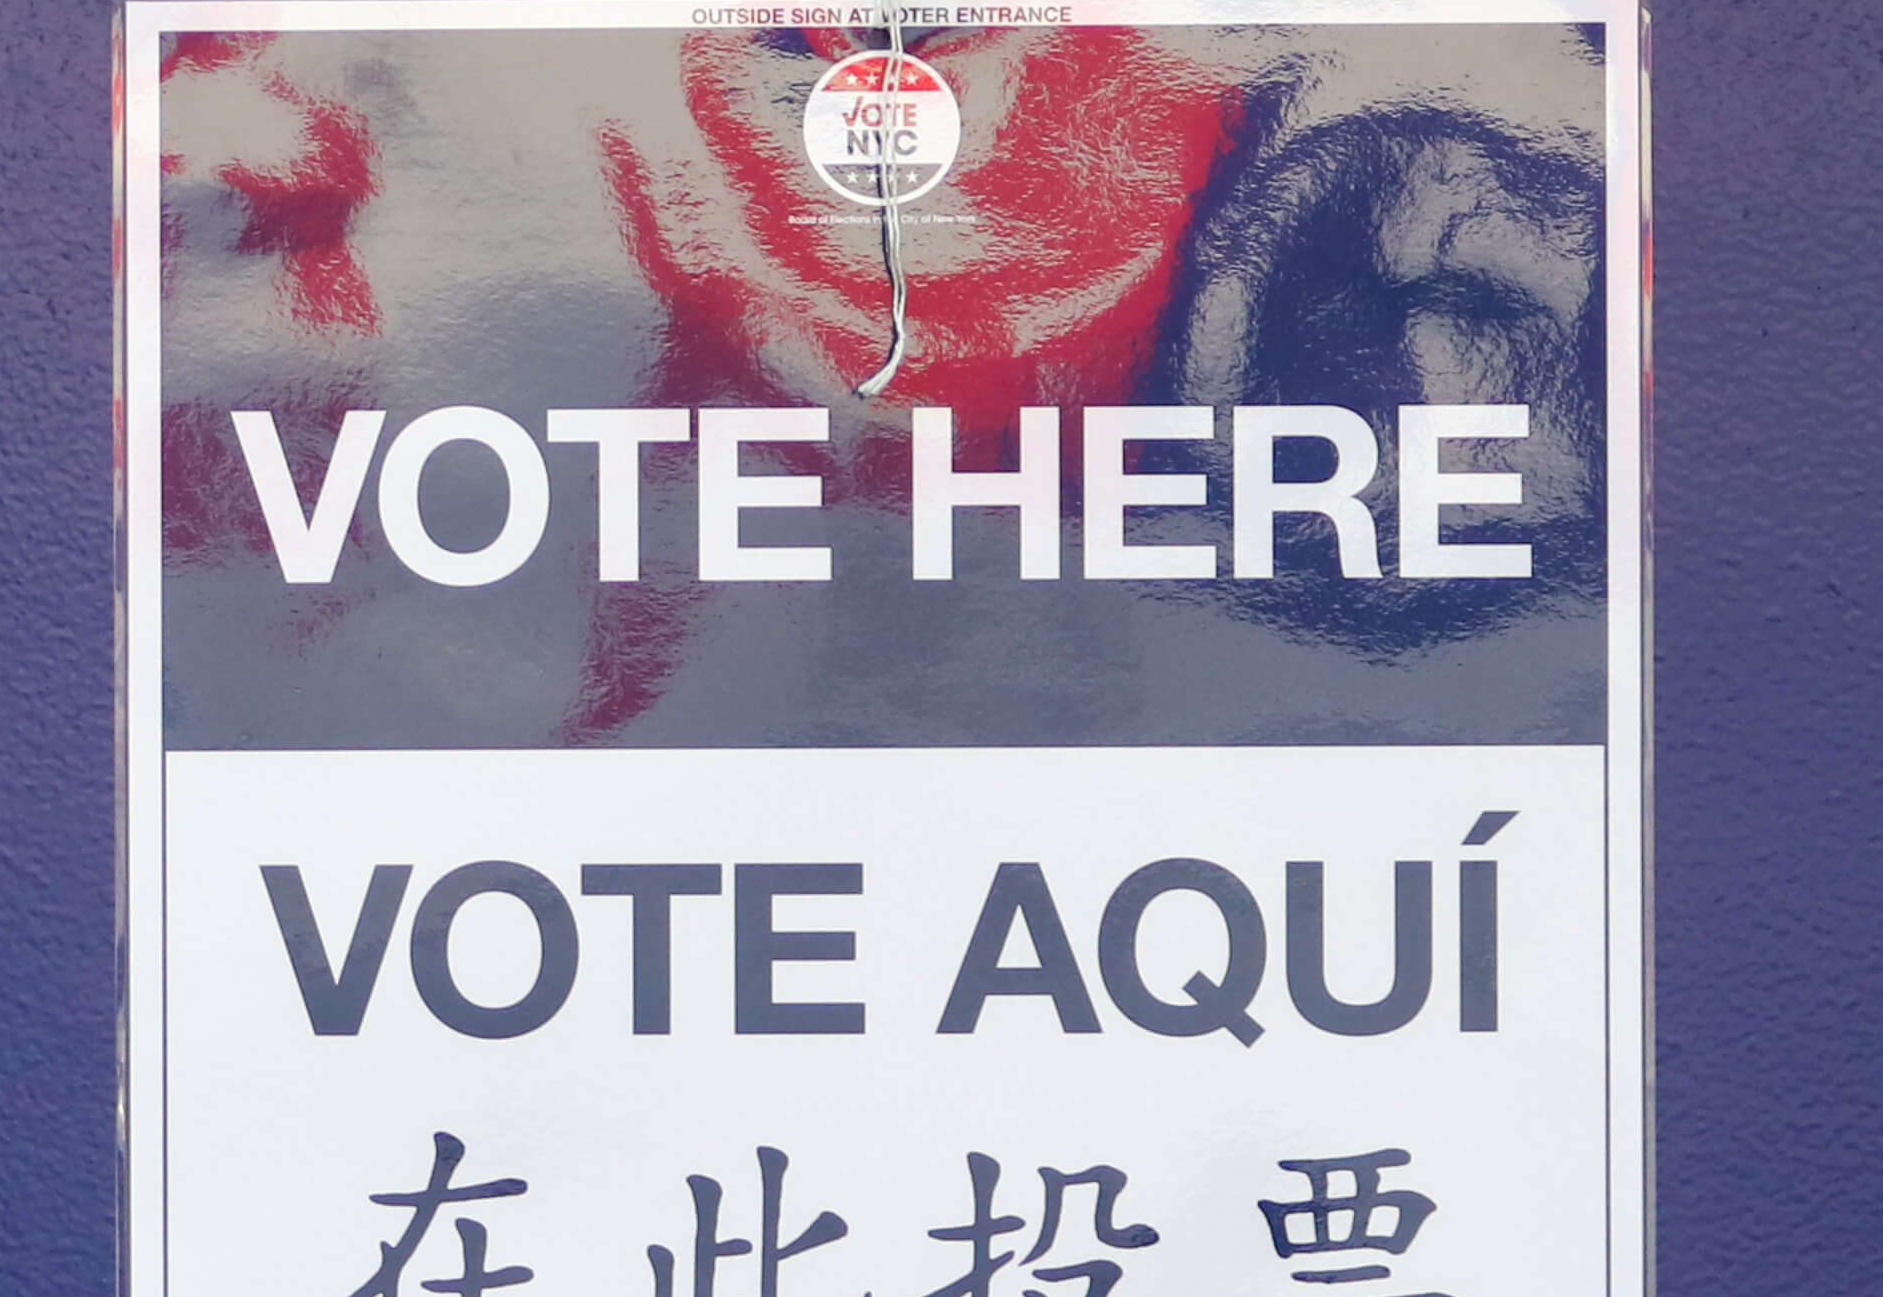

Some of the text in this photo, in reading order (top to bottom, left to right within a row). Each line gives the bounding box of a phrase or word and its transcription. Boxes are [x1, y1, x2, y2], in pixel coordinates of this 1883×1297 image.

[692, 7, 785, 25] OUTSIDE
[790, 7, 842, 25] SIGN
[848, 7, 874, 25] AT
[956, 6, 1073, 23] ENTRANCE
[231, 404, 1532, 586] VOTE HERE
[259, 810, 1519, 1048] VOTE AQUÍ
